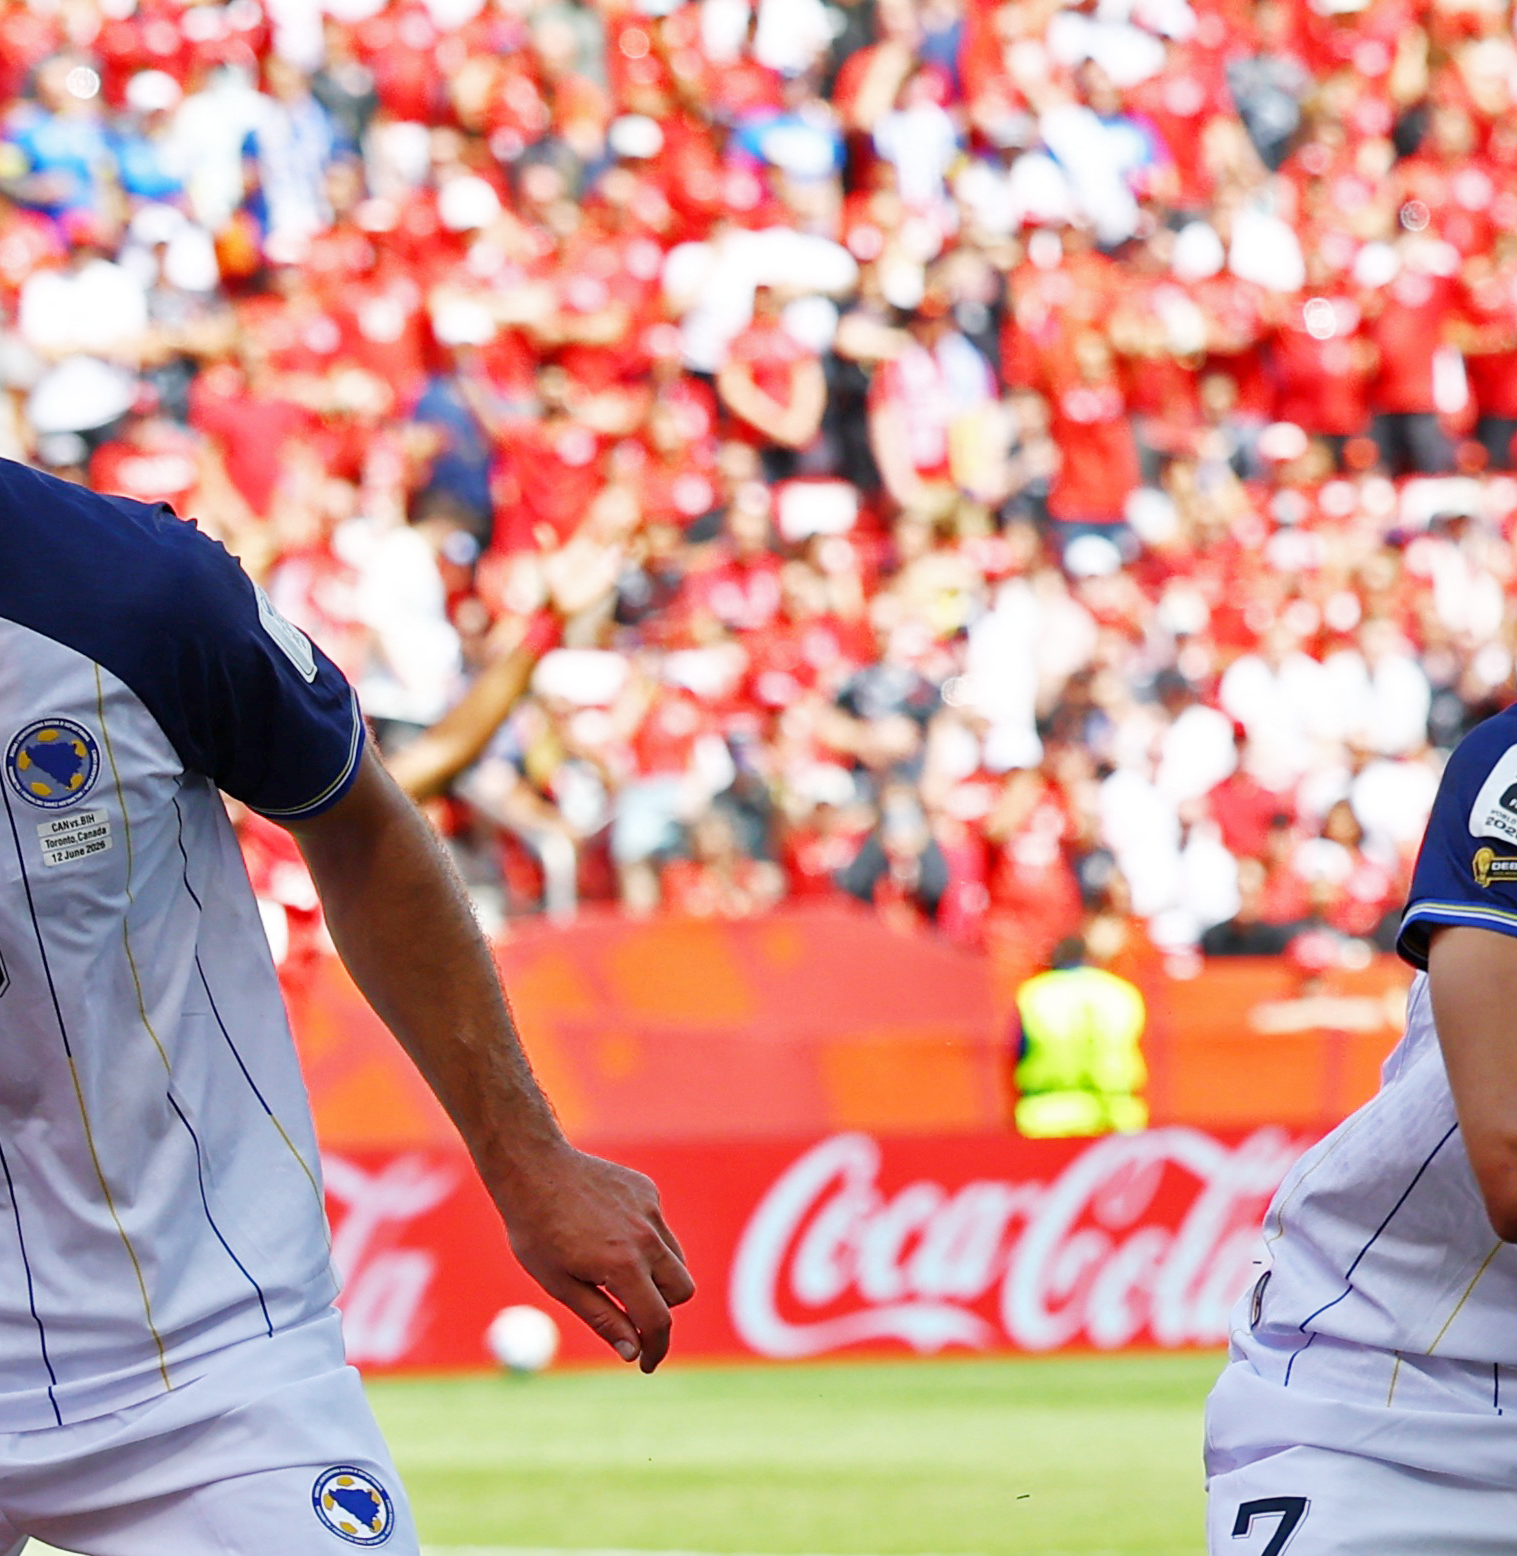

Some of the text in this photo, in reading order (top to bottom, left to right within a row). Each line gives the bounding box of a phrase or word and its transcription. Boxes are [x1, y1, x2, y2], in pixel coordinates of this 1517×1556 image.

[1490, 809, 1516, 825] WORLD
[77, 827, 106, 841] Canada
[52, 852, 63, 863] 12
[64, 846, 85, 860] June
